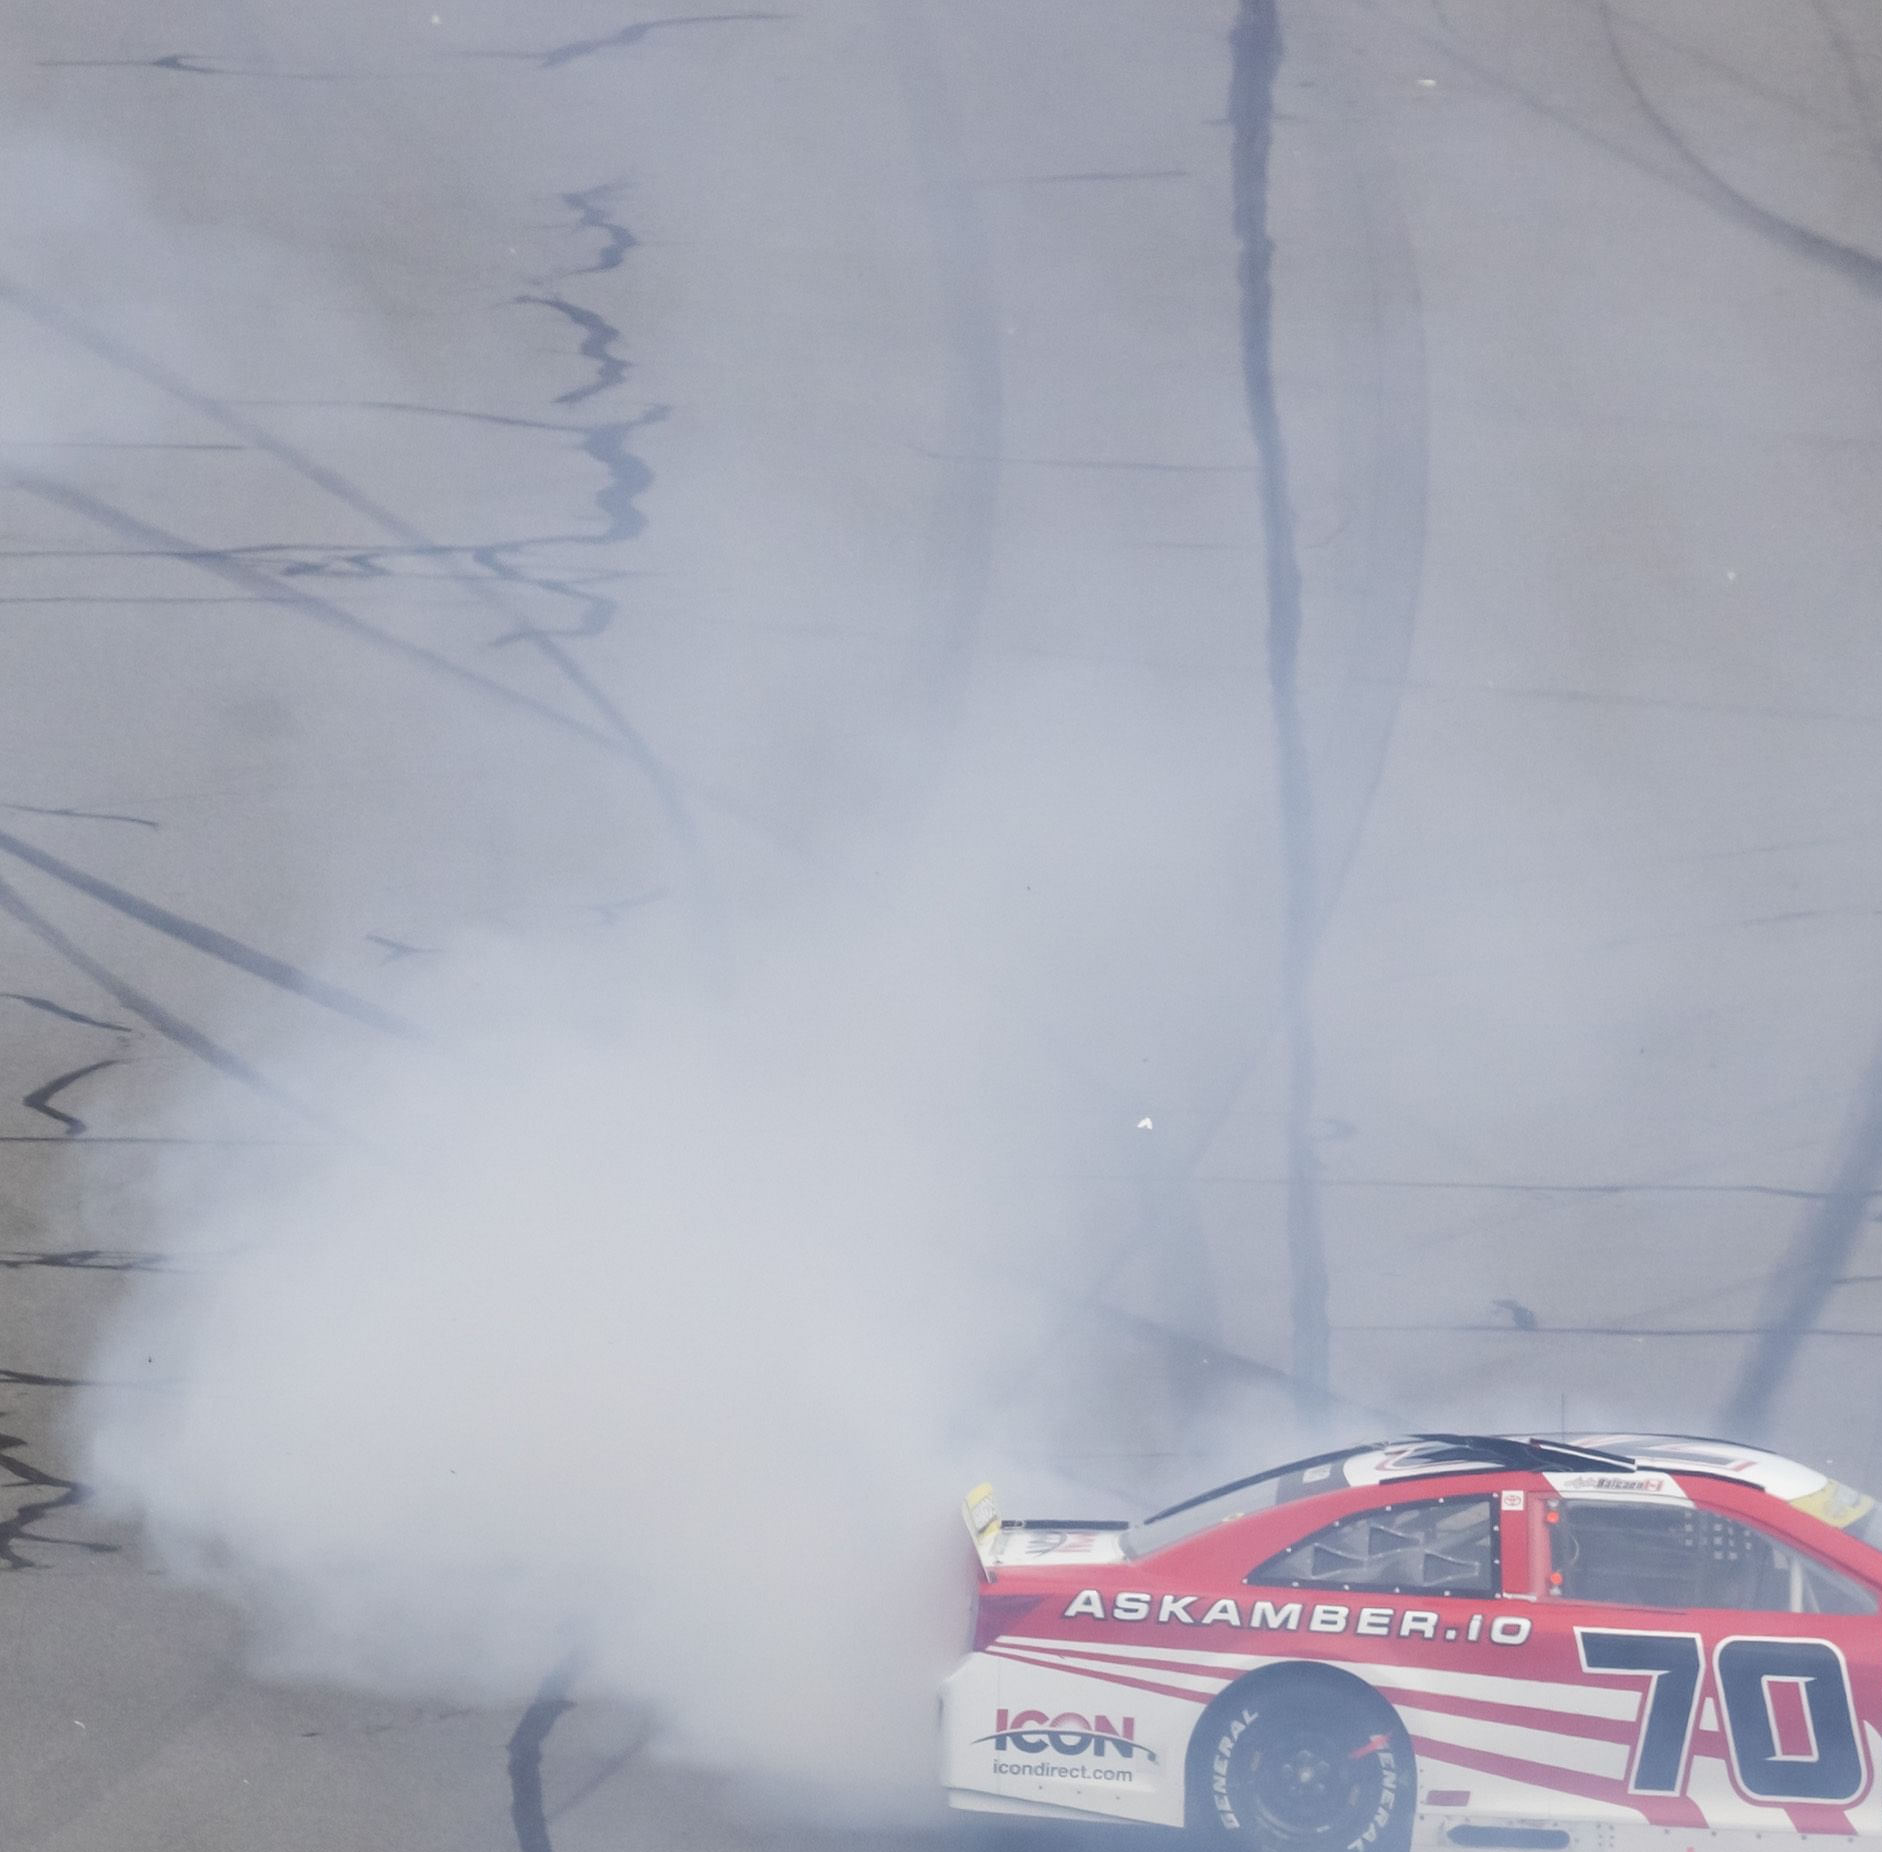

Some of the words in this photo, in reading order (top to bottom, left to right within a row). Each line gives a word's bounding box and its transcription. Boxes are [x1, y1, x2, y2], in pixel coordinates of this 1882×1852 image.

[995, 1709, 1135, 1758] ICON
[1573, 1627, 1870, 1806] 70
[993, 1760, 1133, 1782] icondirect.com
